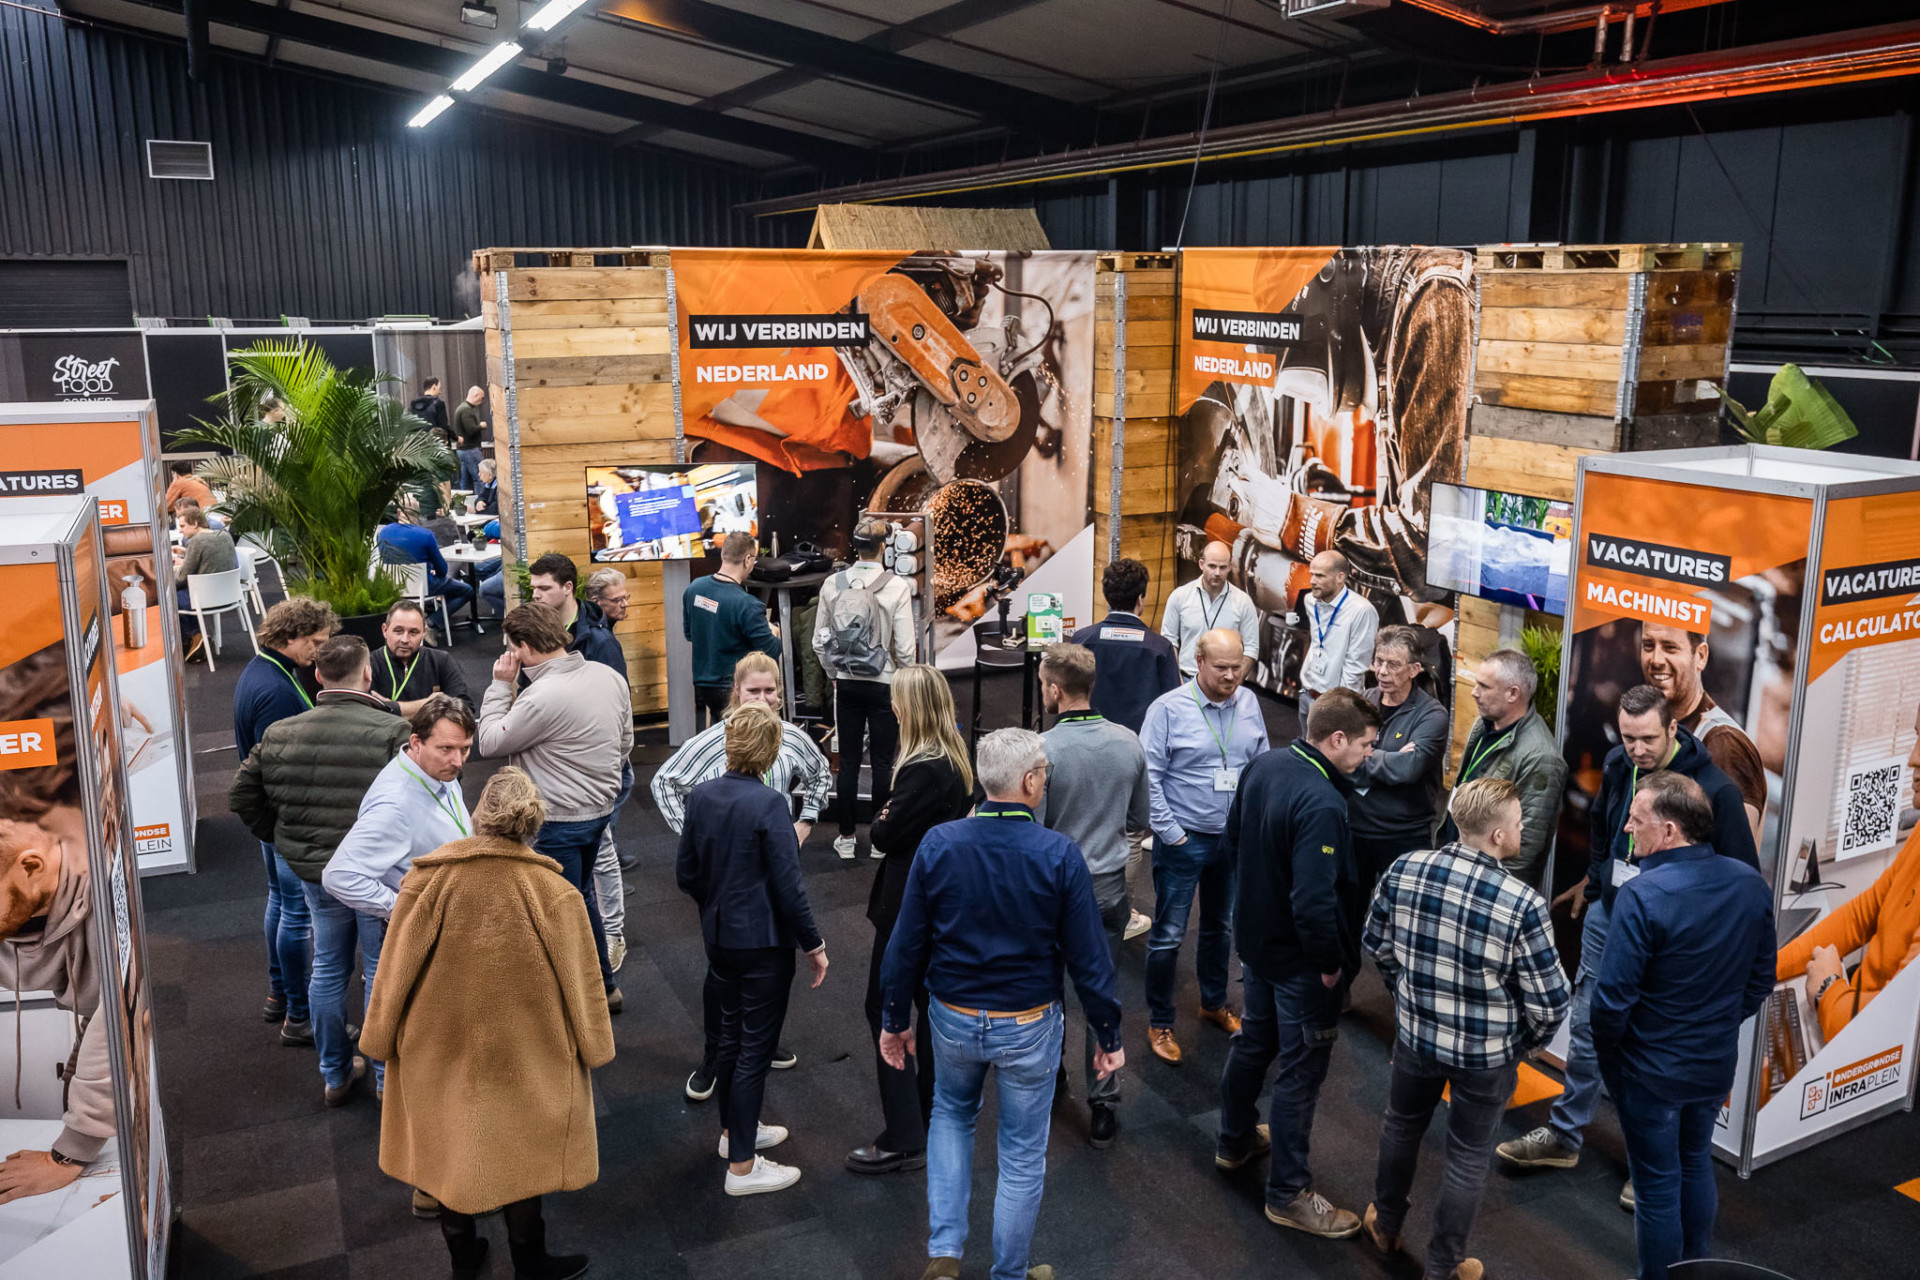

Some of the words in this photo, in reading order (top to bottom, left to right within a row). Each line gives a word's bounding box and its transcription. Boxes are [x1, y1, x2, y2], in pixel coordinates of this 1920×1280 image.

[695, 323, 736, 341] WIJ
[742, 322, 865, 340] VERBINDEN
[1195, 317, 1218, 334] WIJ
[1221, 319, 1300, 340] VERBINDEN
[52, 354, 120, 382] Street
[697, 364, 828, 383] NEDERLAND
[1195, 355, 1272, 379] NEDERLAND
[62, 378, 113, 393] FOOD
[100, 504, 123, 519] ER
[1591, 540, 1725, 582] VACATURES
[1826, 566, 1920, 597] VACATURE
[1587, 582, 1707, 624] MACHINIST
[1820, 609, 1920, 644] CALCULATO
[0, 732, 43, 755] ER
[138, 838, 172, 852] LEIN
[1834, 1050, 1901, 1083] ONDERGRONDSE
[1829, 1065, 1901, 1104] INFRAPLEIN
